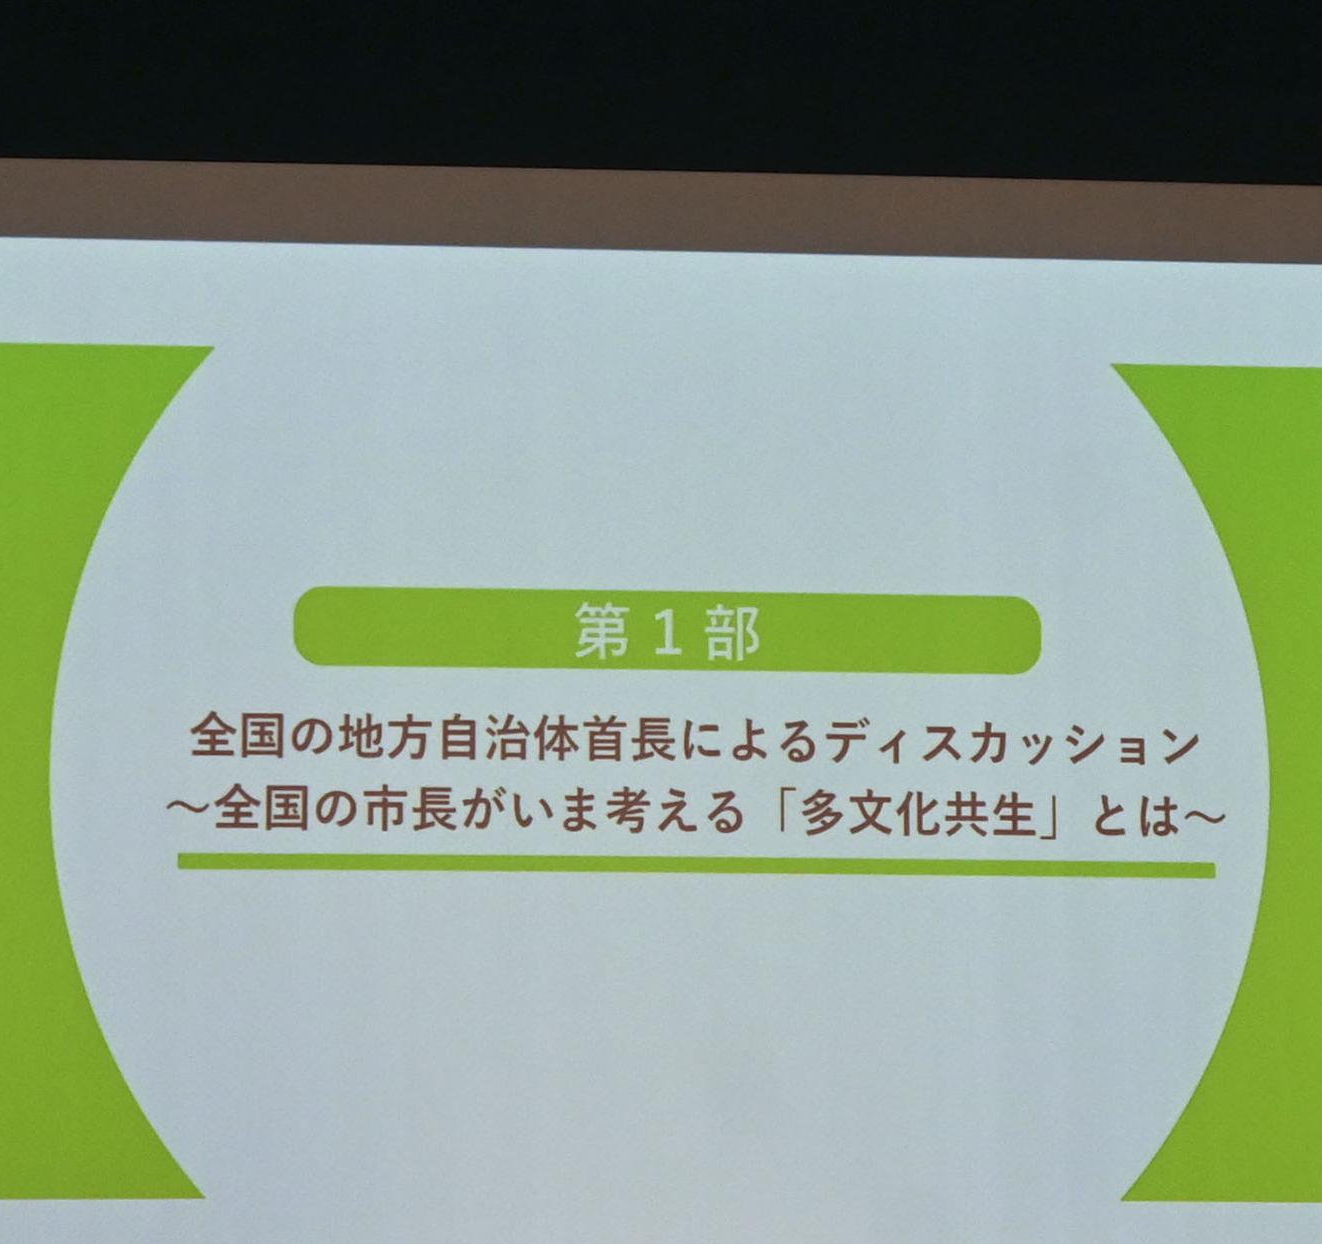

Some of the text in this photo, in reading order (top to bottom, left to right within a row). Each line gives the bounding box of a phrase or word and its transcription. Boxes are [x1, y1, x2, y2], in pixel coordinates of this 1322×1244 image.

[189, 710, 1200, 766] 全国の地方自治体首長によるディスカッション
